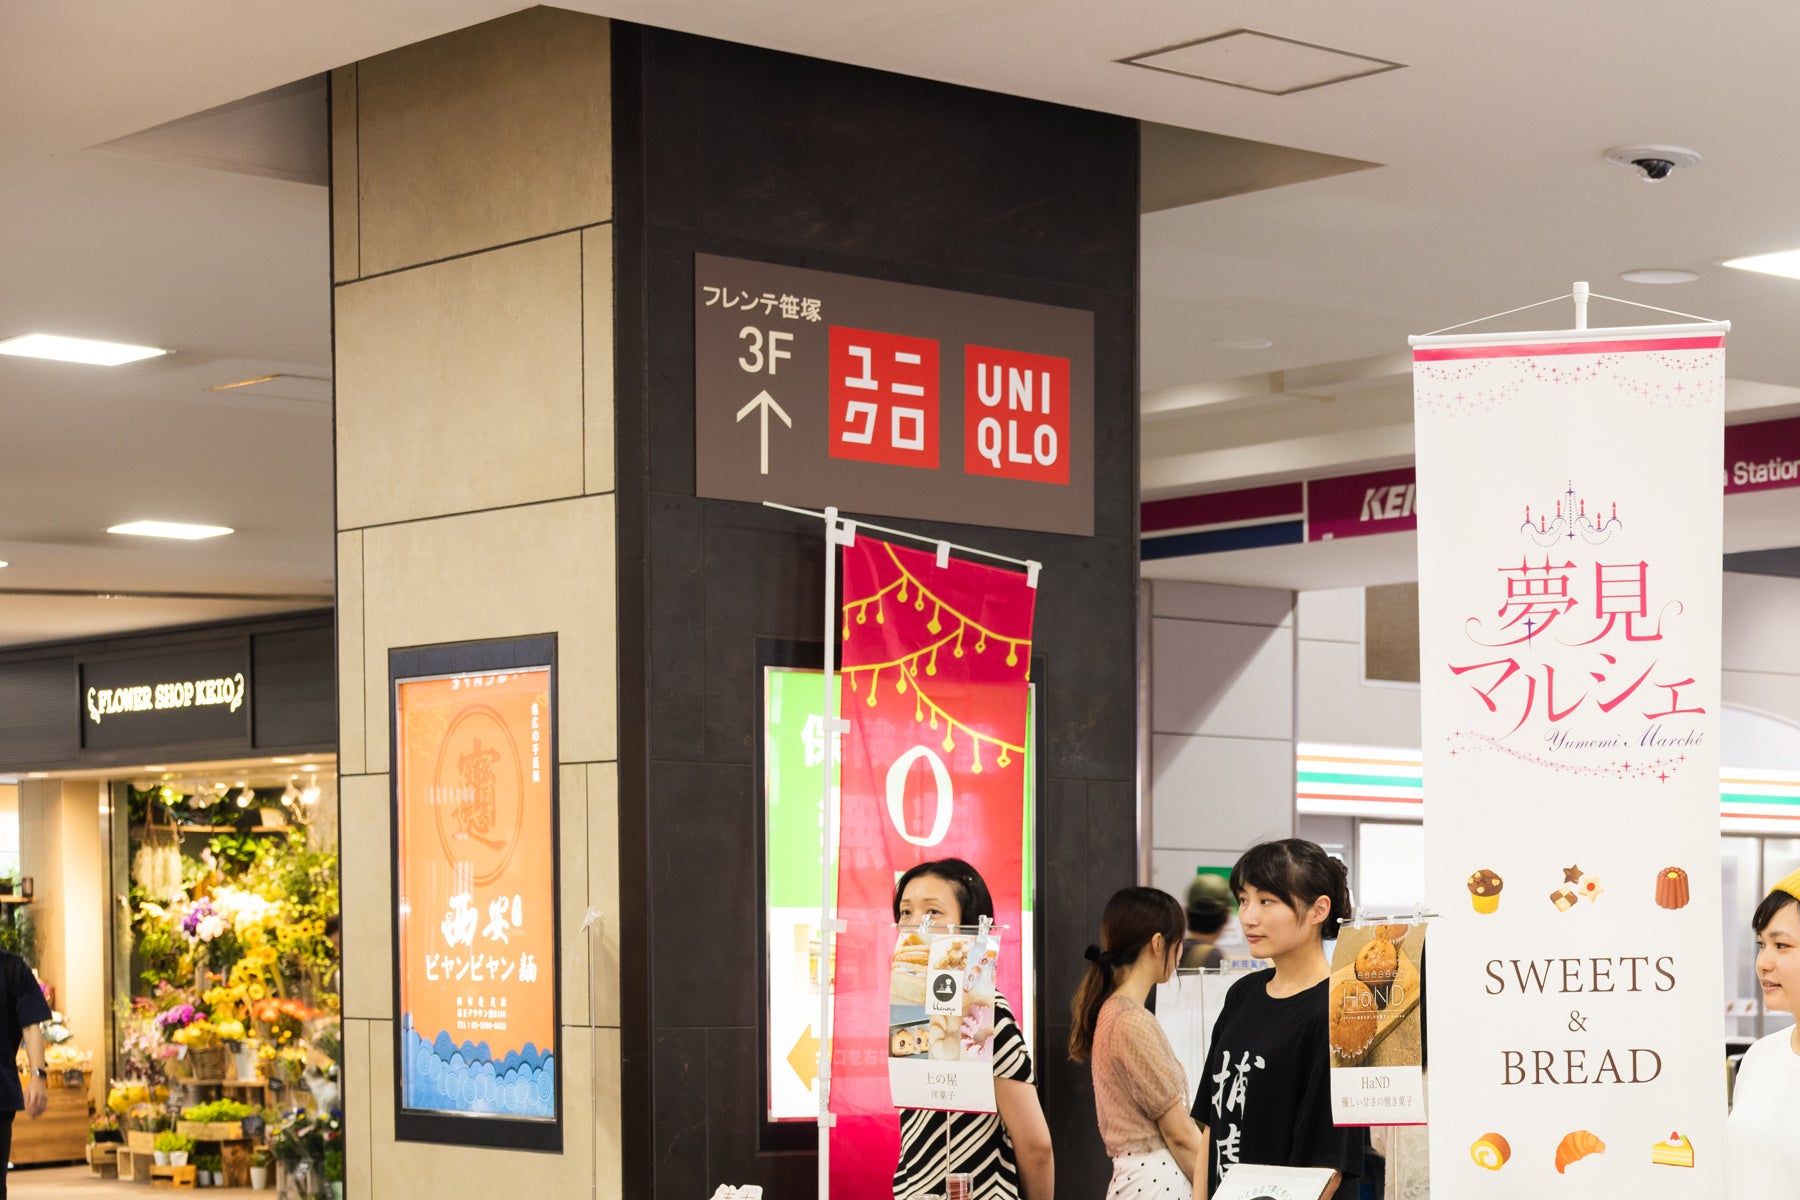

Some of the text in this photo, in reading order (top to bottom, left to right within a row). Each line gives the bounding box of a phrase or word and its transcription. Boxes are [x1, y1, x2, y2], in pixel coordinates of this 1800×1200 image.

[703, 286, 822, 322] フレンテ笹塚
[738, 325, 794, 375] 3F
[977, 363, 1050, 414] UNI
[977, 417, 1057, 468] QLO
[1360, 484, 1417, 522] KEI
[1465, 553, 1683, 650] 夢見
[98, 678, 235, 714] FLOWER SHOP KEIO
[1447, 653, 1706, 742] マルシェ
[1544, 724, 1703, 752] Yumemi Marché
[1485, 956, 1676, 995] SWEETS
[1568, 1010, 1588, 1032] &
[925, 1072, 958, 1086] 上の屋
[1361, 1076, 1390, 1089] HaND
[1501, 1049, 1662, 1085] BREAD
